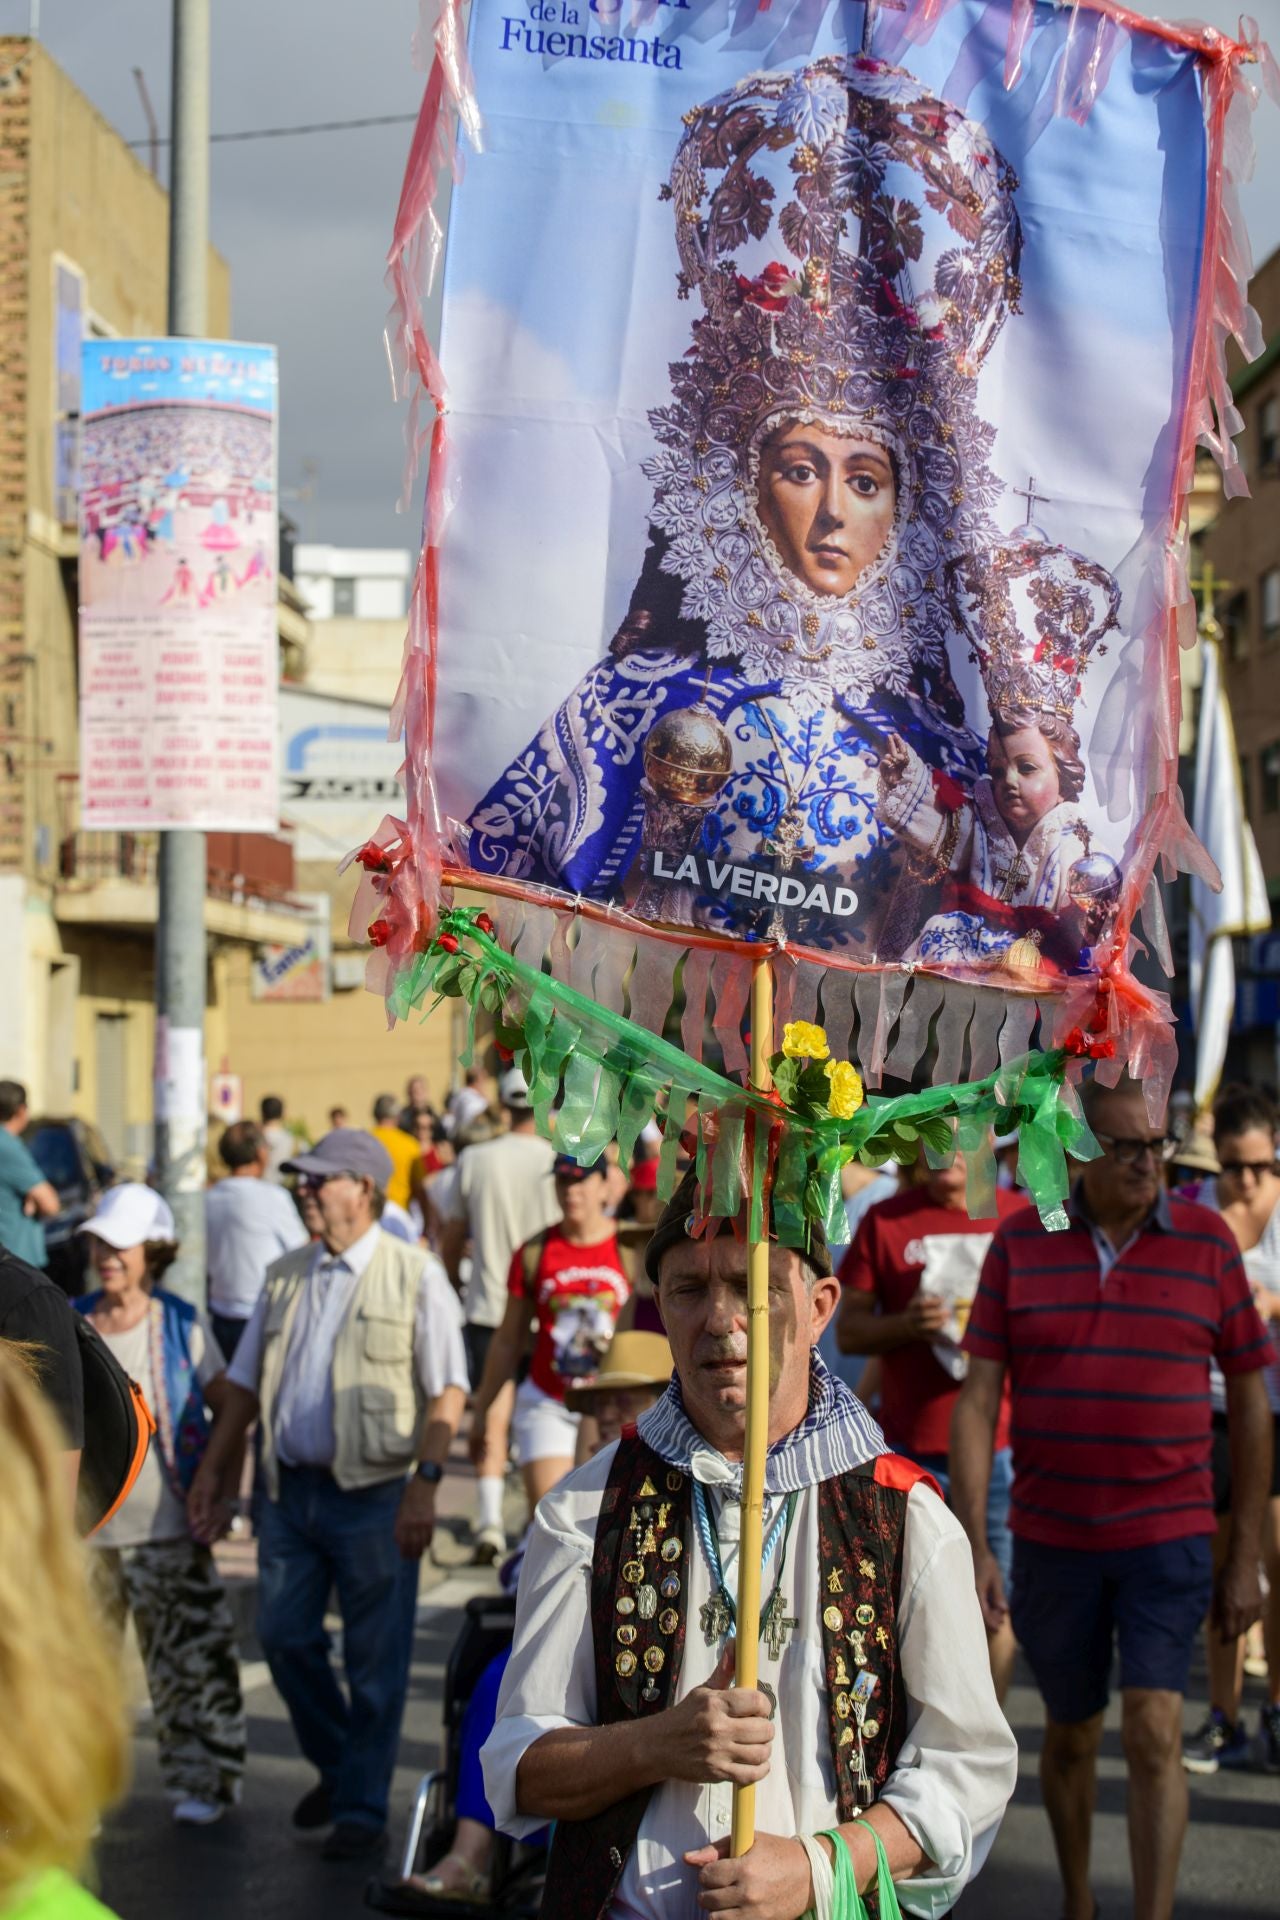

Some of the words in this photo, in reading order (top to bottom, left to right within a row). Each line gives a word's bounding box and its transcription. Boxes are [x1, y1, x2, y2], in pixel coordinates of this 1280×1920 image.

[529, 0, 556, 22] de
[561, 2, 579, 25] la
[499, 16, 684, 70] Fuensanta
[653, 850, 701, 885] LA
[706, 859, 859, 917] VERDAD
